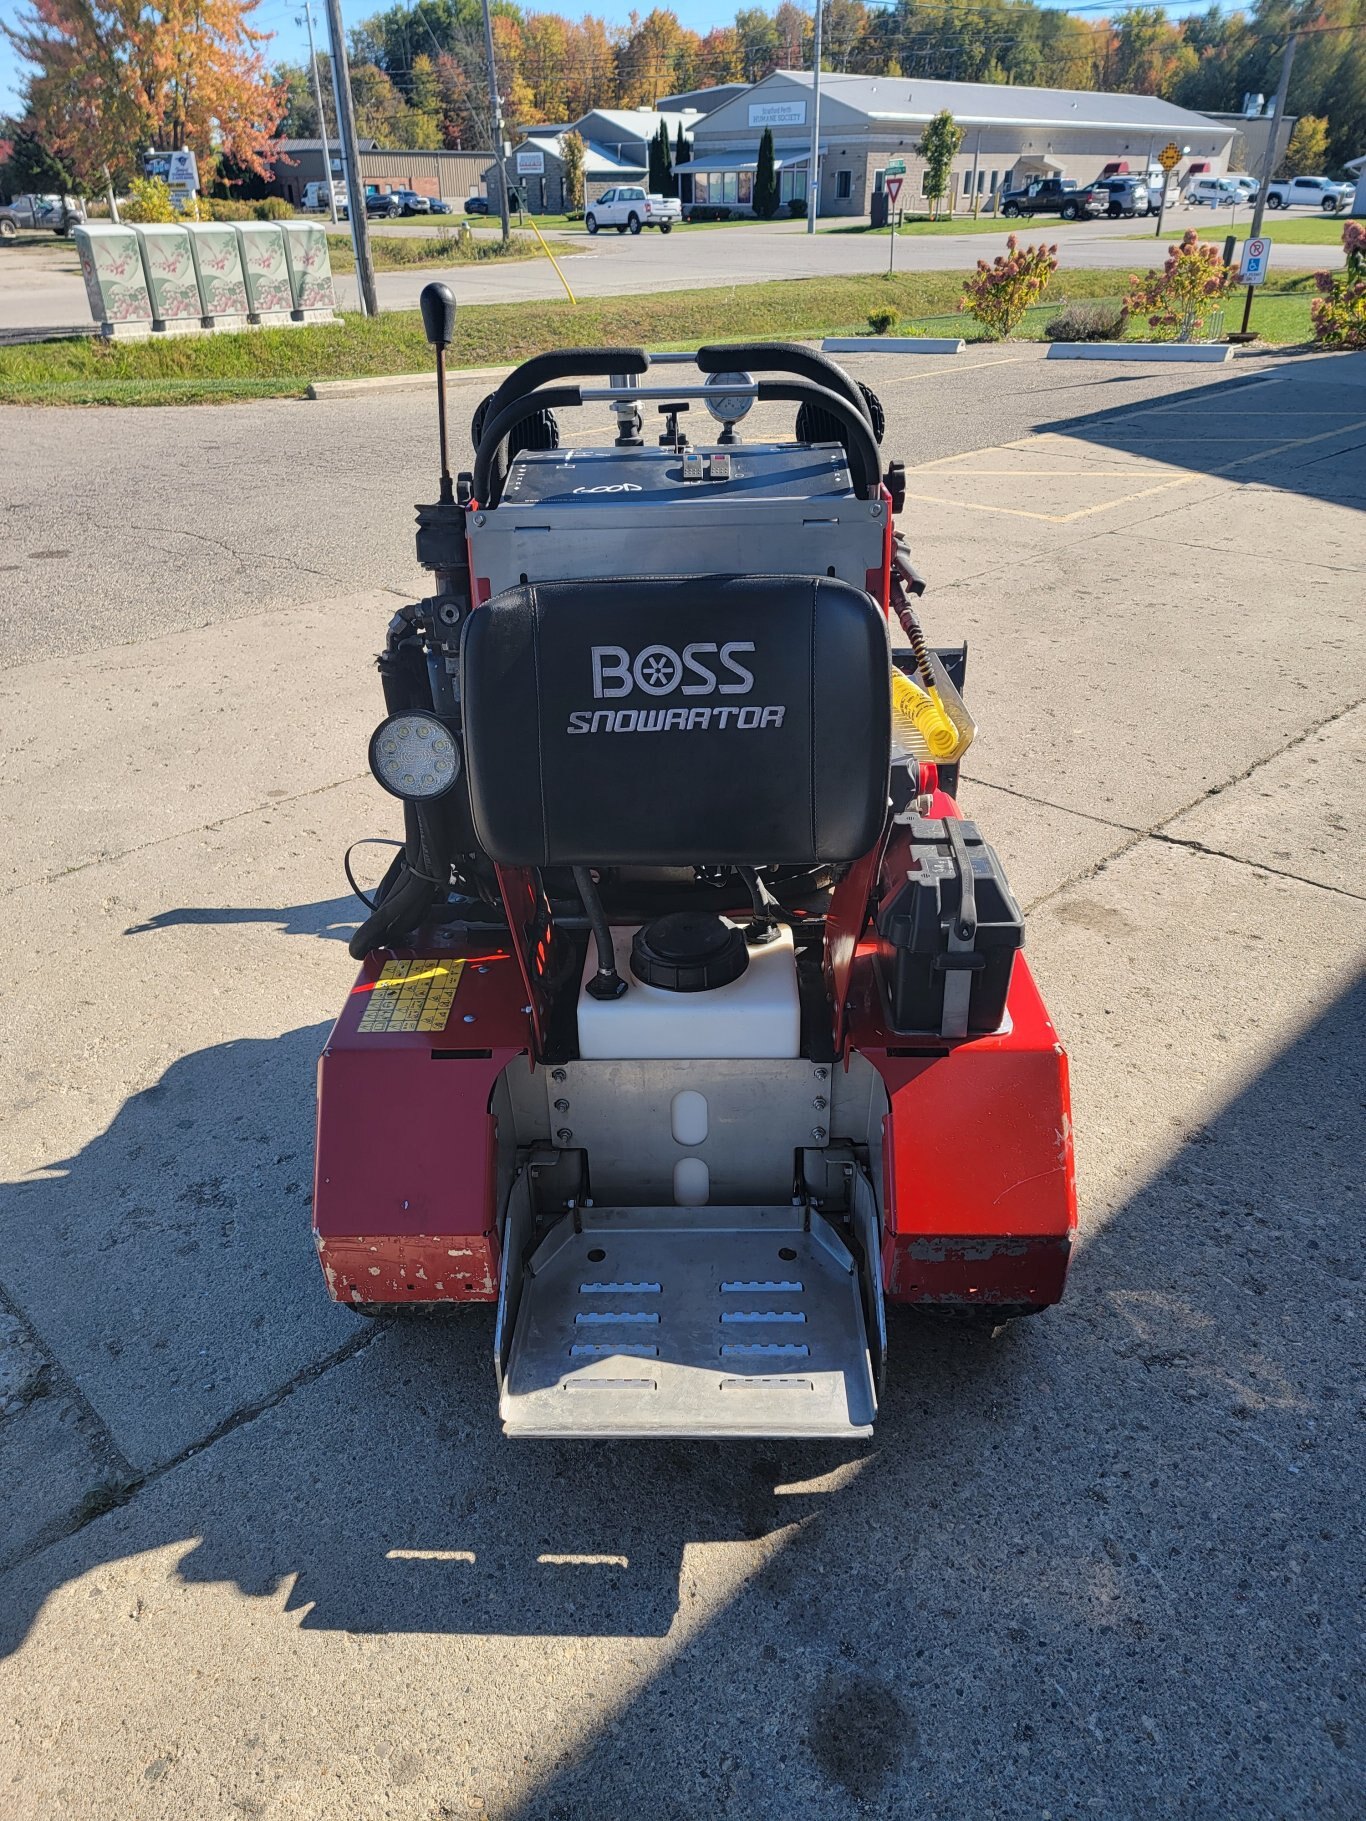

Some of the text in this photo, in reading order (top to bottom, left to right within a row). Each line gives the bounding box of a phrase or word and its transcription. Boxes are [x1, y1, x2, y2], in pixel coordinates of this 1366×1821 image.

[753, 113, 801, 123] HUMANE SOCIETY
[573, 483, 643, 494] GOOD
[591, 641, 756, 699] BOSS
[567, 705, 785, 734] SNOWRATOR
